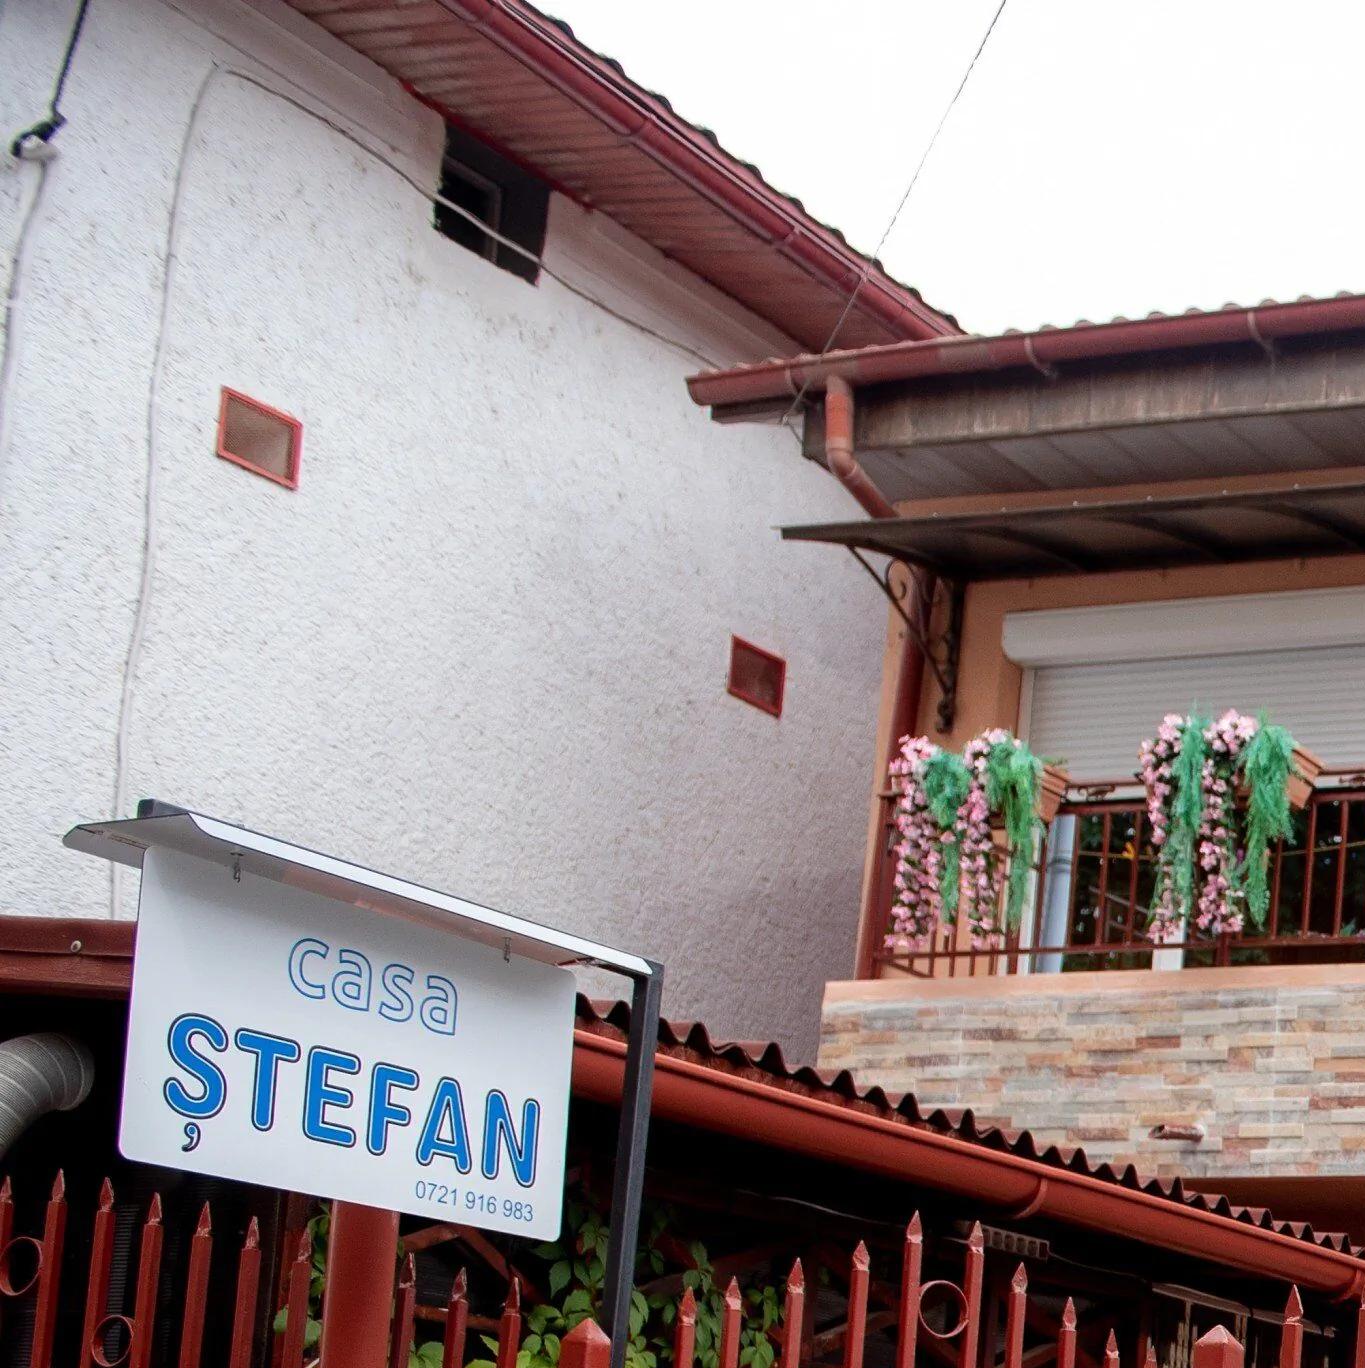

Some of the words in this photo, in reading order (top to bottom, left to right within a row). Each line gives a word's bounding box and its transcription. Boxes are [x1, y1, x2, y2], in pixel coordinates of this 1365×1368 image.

[288, 936, 459, 1036] casa
[163, 1012, 541, 1188] ȘTEFAN
[415, 1180, 458, 1207] 0721
[465, 1190, 497, 1216] 916
[502, 1197, 534, 1222] 983
